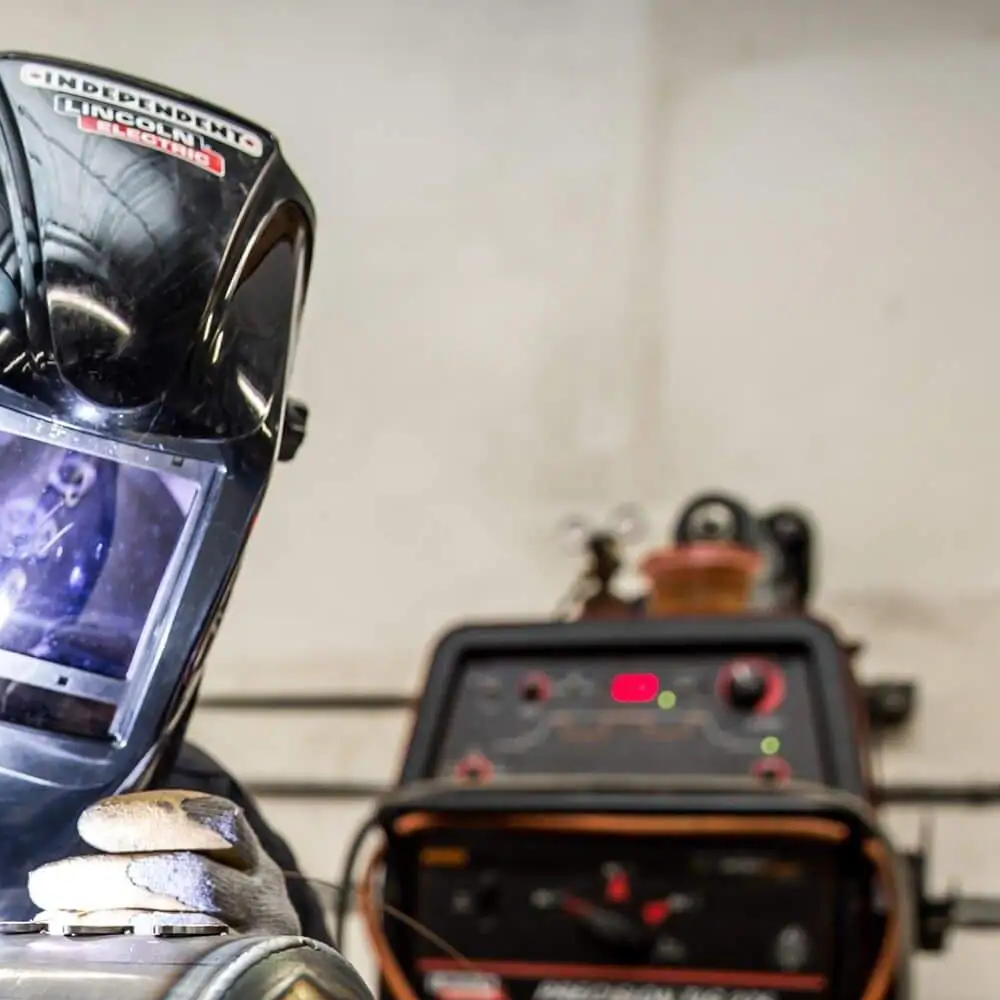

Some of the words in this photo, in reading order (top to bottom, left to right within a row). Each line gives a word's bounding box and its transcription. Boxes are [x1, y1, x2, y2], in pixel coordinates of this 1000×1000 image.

[45, 72, 243, 145] INDEPENDENT
[64, 98, 200, 146] LINCOLN
[95, 120, 210, 166] ELECTRIC
